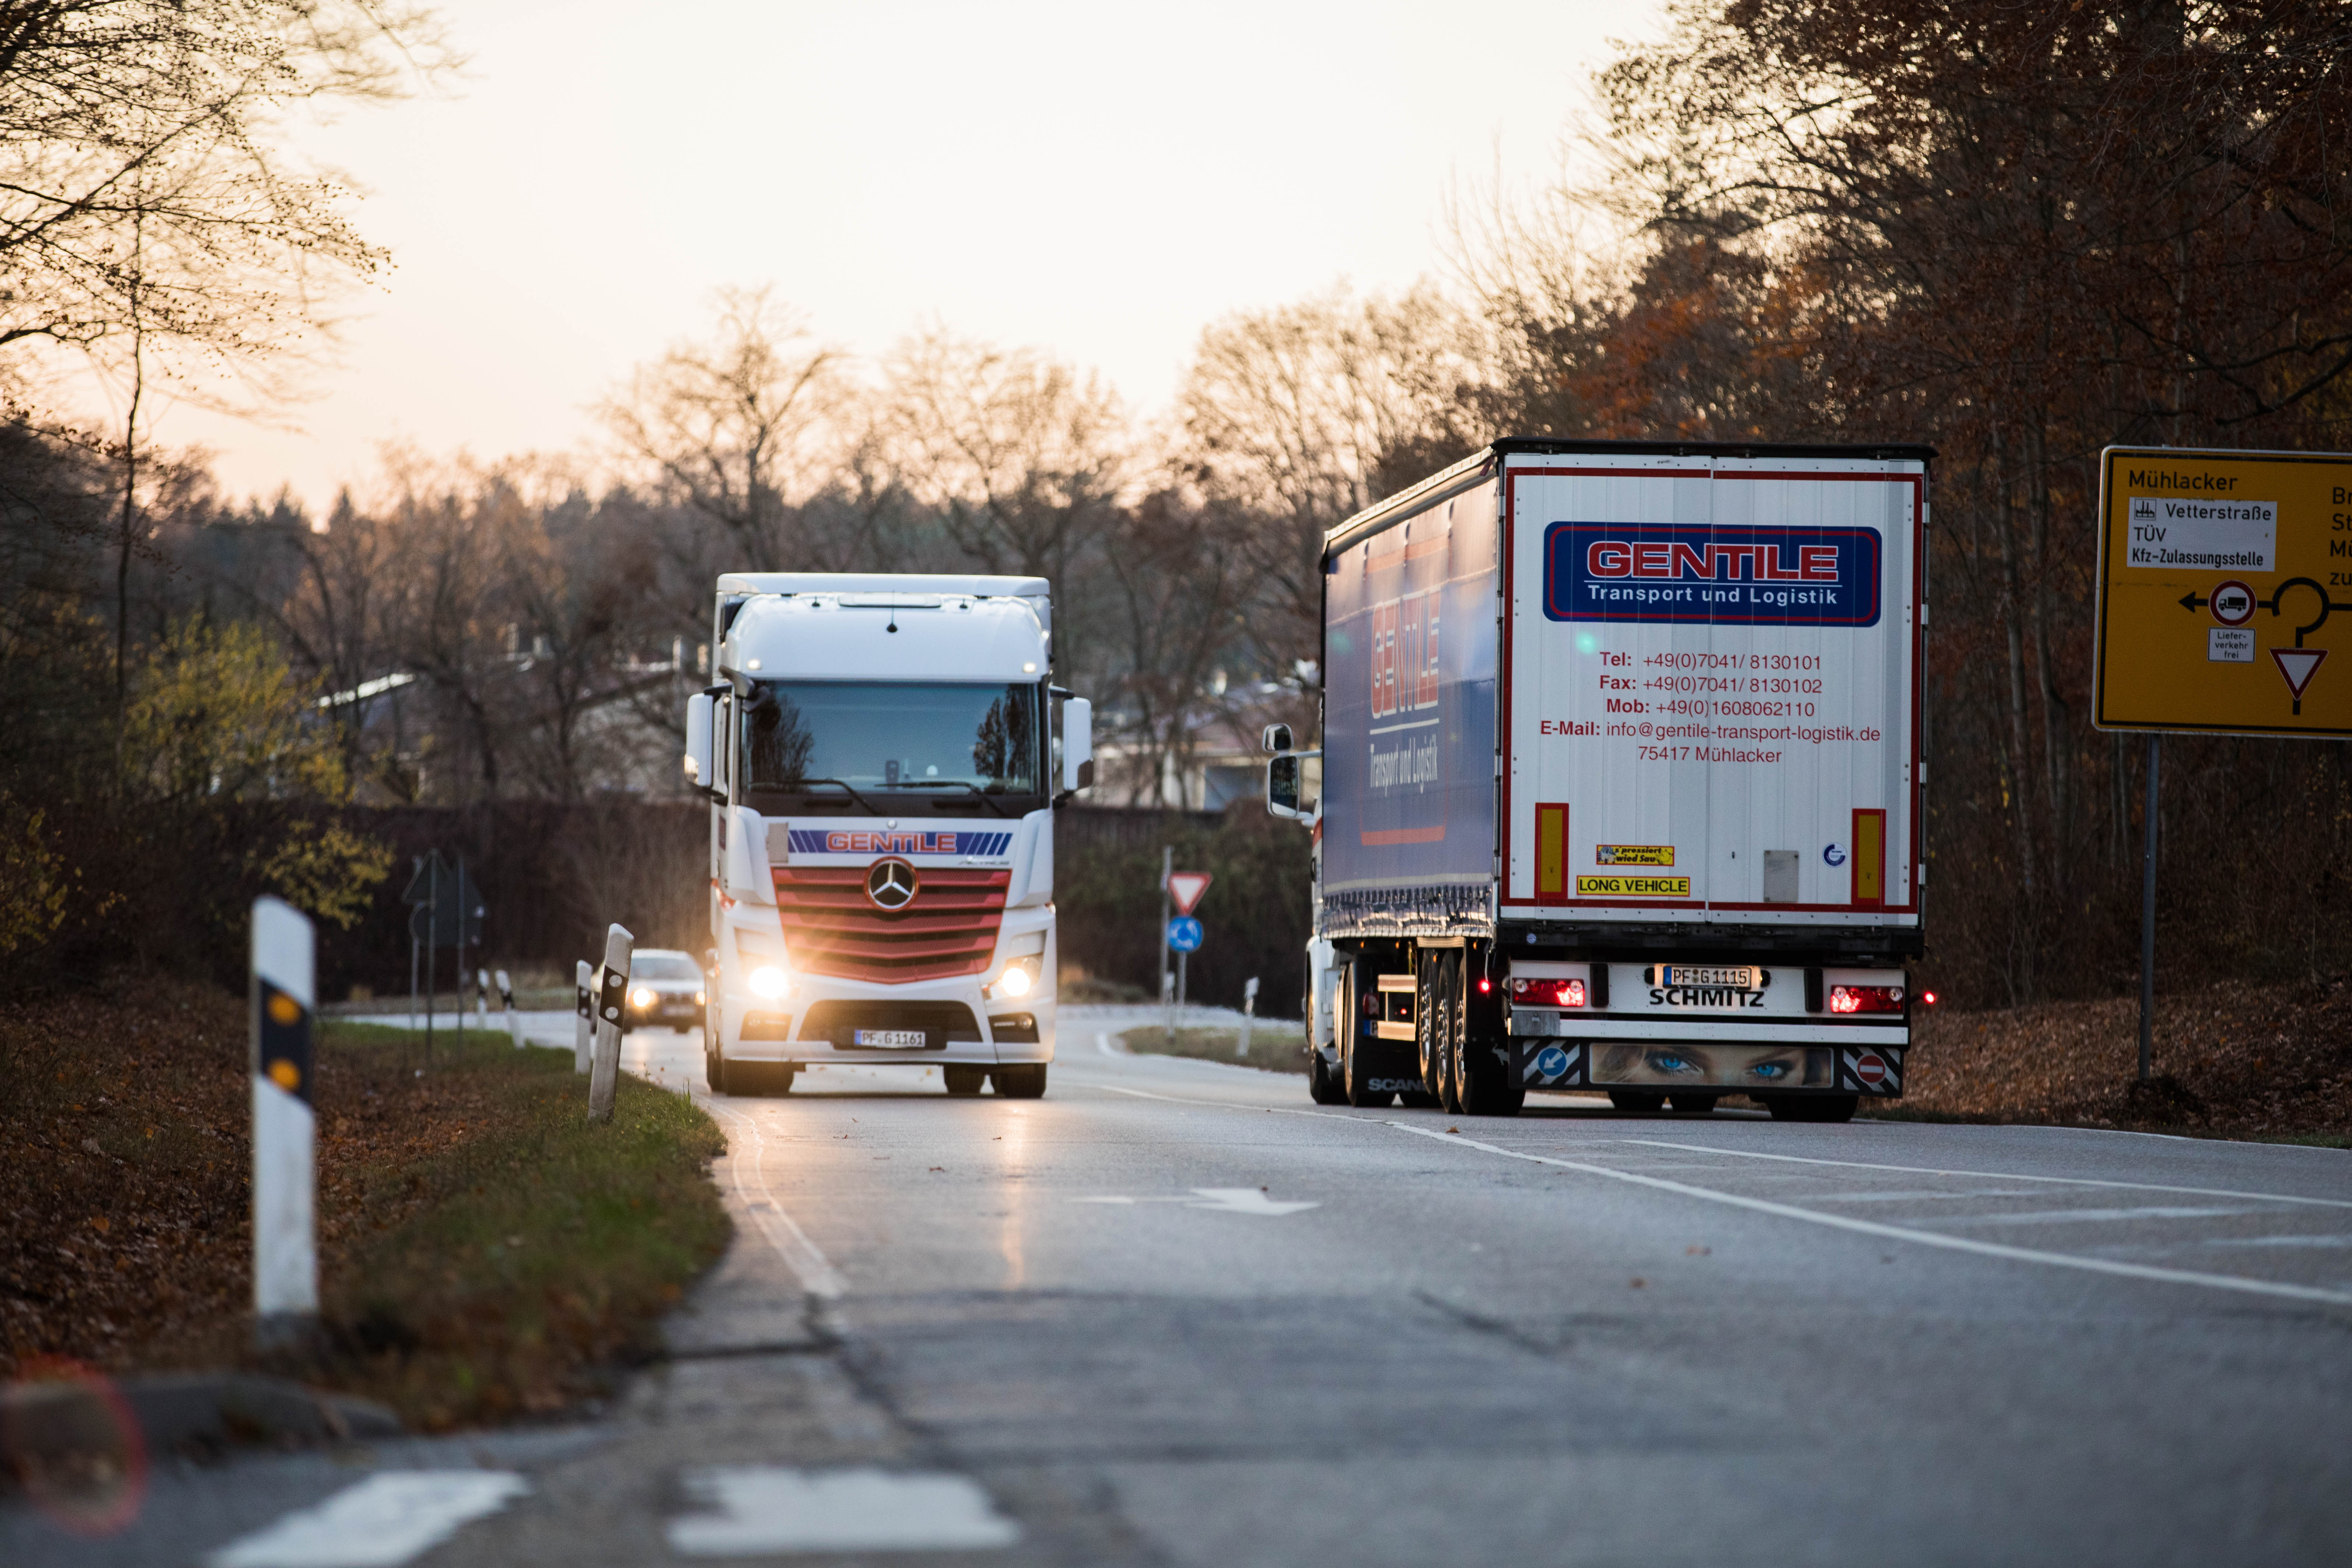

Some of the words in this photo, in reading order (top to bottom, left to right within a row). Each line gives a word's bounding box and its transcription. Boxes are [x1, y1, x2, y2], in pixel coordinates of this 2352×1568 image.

[2129, 470, 2238, 490] Mühlacker
[2166, 503, 2271, 521] Vetterstraße
[2134, 525, 2166, 542] TÜV
[1587, 541, 1838, 582] GENTILE
[2132, 548, 2264, 569] Kfz-Zulassungsstelle
[1588, 585, 1692, 603] Transport
[1702, 588, 1739, 602] und
[1750, 588, 1836, 606] Logistik
[2217, 631, 2246, 640] Liefer-
[1370, 585, 1441, 719] GENTILE
[2215, 641, 2249, 650] verkehr
[2224, 650, 2239, 659] frei
[1599, 651, 1631, 667] Tel:
[1750, 655, 1820, 670] 8130101
[1599, 674, 1636, 690] Fax:
[1750, 678, 1822, 694] 8130102
[1606, 698, 1650, 714] Mob:
[1656, 700, 1815, 717] +49(0)1608062110
[1540, 720, 1600, 736] E-Mail:
[1638, 746, 1690, 761] 75417
[1696, 746, 1782, 763] Mühlacker
[1370, 743, 1398, 797] Transport
[1399, 737, 1411, 784] und
[1413, 734, 1438, 794] Logistik
[826, 831, 957, 852] GENTILE
[1640, 855, 1656, 863] Sau
[1580, 879, 1620, 891] LONG
[1624, 880, 1687, 892] VEHICLE
[1649, 989, 1765, 1007] SCHMITZ
[1367, 1078, 1426, 1092] SCAN
